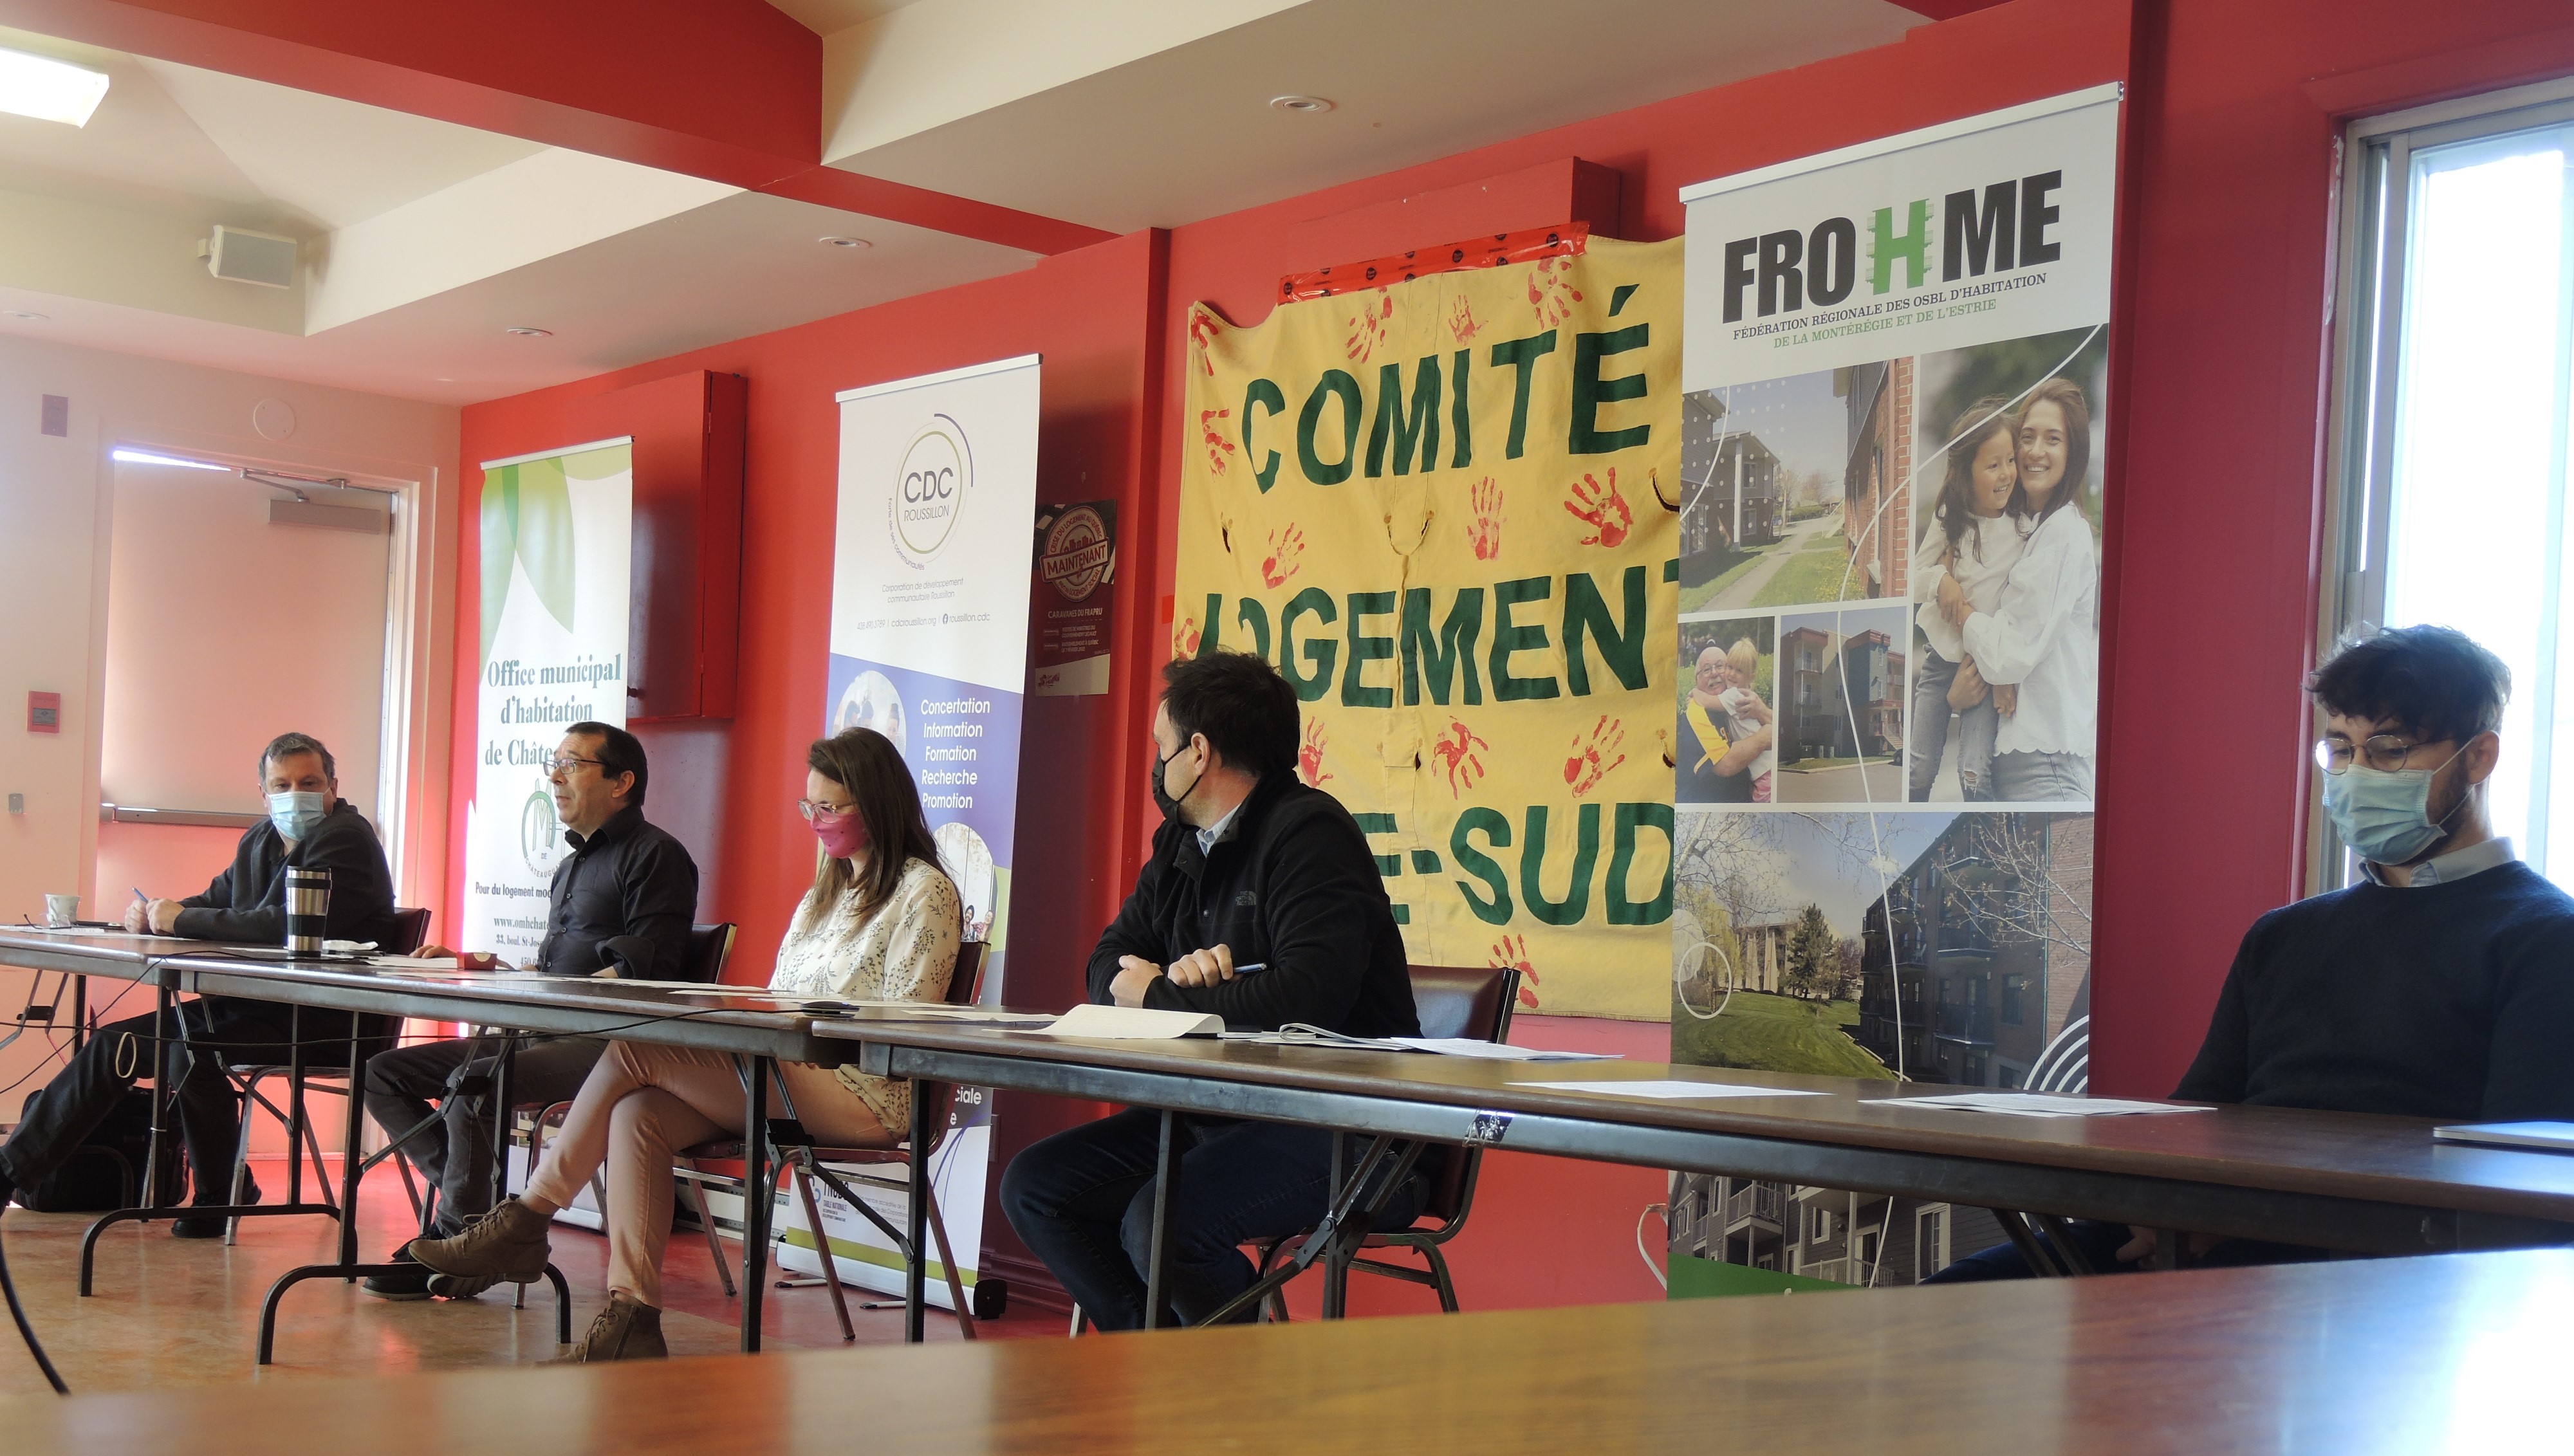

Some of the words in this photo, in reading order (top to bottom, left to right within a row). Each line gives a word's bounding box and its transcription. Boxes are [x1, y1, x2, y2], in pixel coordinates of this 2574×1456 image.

[1733, 318, 1809, 340] FÉDÉRATION
[1812, 305, 1882, 326] RÉGIONALE
[1885, 300, 1911, 313] DES
[1913, 292, 1947, 307] OSBL
[1950, 273, 2047, 302] D'HABITATION
[1773, 337, 1790, 348] DE
[1792, 334, 1809, 345] LA
[1811, 317, 1893, 342] MONTÉRÉGIE
[1896, 314, 1914, 327] ET
[1916, 311, 1934, 324] DE
[1937, 299, 1996, 319] L'ESTRIE
[1241, 284, 1651, 494] COMITÉ
[904, 467, 954, 503] CDC
[904, 505, 950, 522] ROUSSILLON
[1051, 535, 1060, 553] CRISE
[1057, 526, 1065, 536] DU
[1047, 544, 1106, 576] MAINTENANT
[915, 581, 922, 590] de
[1048, 609, 1077, 618] CARAVANES
[1085, 607, 1103, 616] FRAPRU
[488, 659, 535, 687] Office
[540, 653, 621, 688] municipal
[921, 697, 990, 715] Concertation
[923, 722, 983, 738] Information
[485, 740, 502, 765] de
[508, 739, 553, 766] Châte
[925, 746, 976, 761] Formation
[921, 769, 977, 785] Recherche
[922, 793, 972, 809] Promotion
[476, 881, 490, 894] Pour
[492, 883, 501, 895] du
[503, 884, 534, 898] logement
